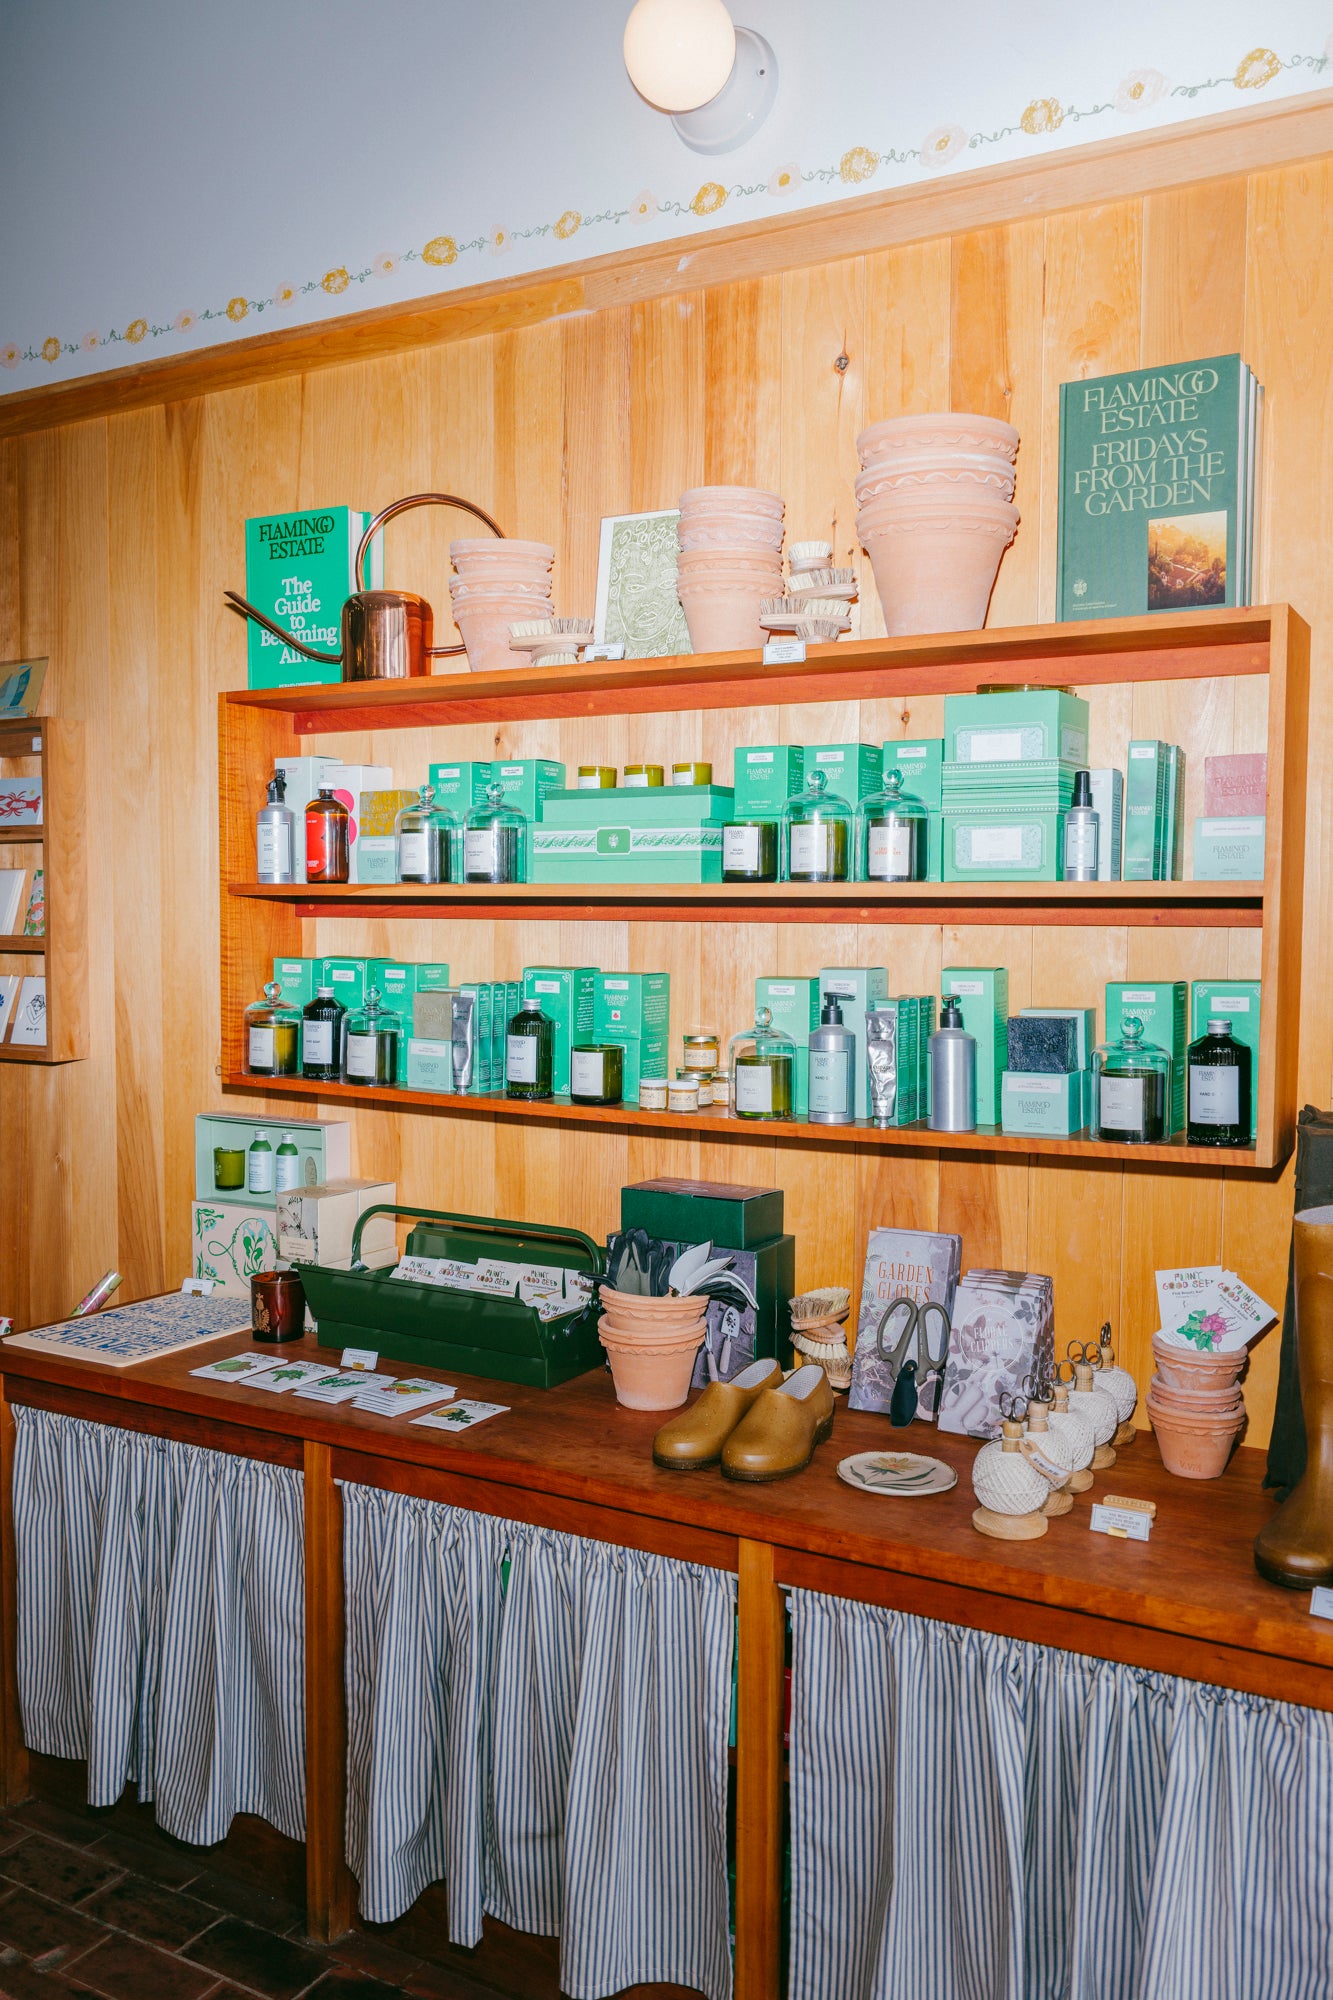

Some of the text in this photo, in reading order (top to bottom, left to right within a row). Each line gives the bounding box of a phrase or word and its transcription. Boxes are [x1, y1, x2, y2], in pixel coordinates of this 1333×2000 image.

[1082, 367, 1219, 413] FLAMINGO
[1099, 396, 1200, 435] ESTATE
[1091, 428, 1209, 468] FRIDAYS
[1073, 451, 1227, 495] FROM THE
[1084, 477, 1213, 517] GARDEN
[259, 515, 336, 542] FLAMINGO
[269, 536, 326, 561] ESTATE
[281, 576, 313, 596] The
[274, 594, 322, 616] Guide
[289, 614, 306, 630] to
[486, 1268, 505, 1278] PLANT
[530, 1269, 550, 1279] PLANT
[877, 1261, 934, 1285] GARDEN
[1174, 1271, 1203, 1281] PLANT
[877, 1282, 931, 1304] GLOVES
[1162, 1281, 1189, 1290] GOOD
[1233, 1284, 1260, 1307] PLANT
[1217, 1282, 1261, 1322] GOOD SEED
[973, 1325, 1009, 1340] FLORAL
